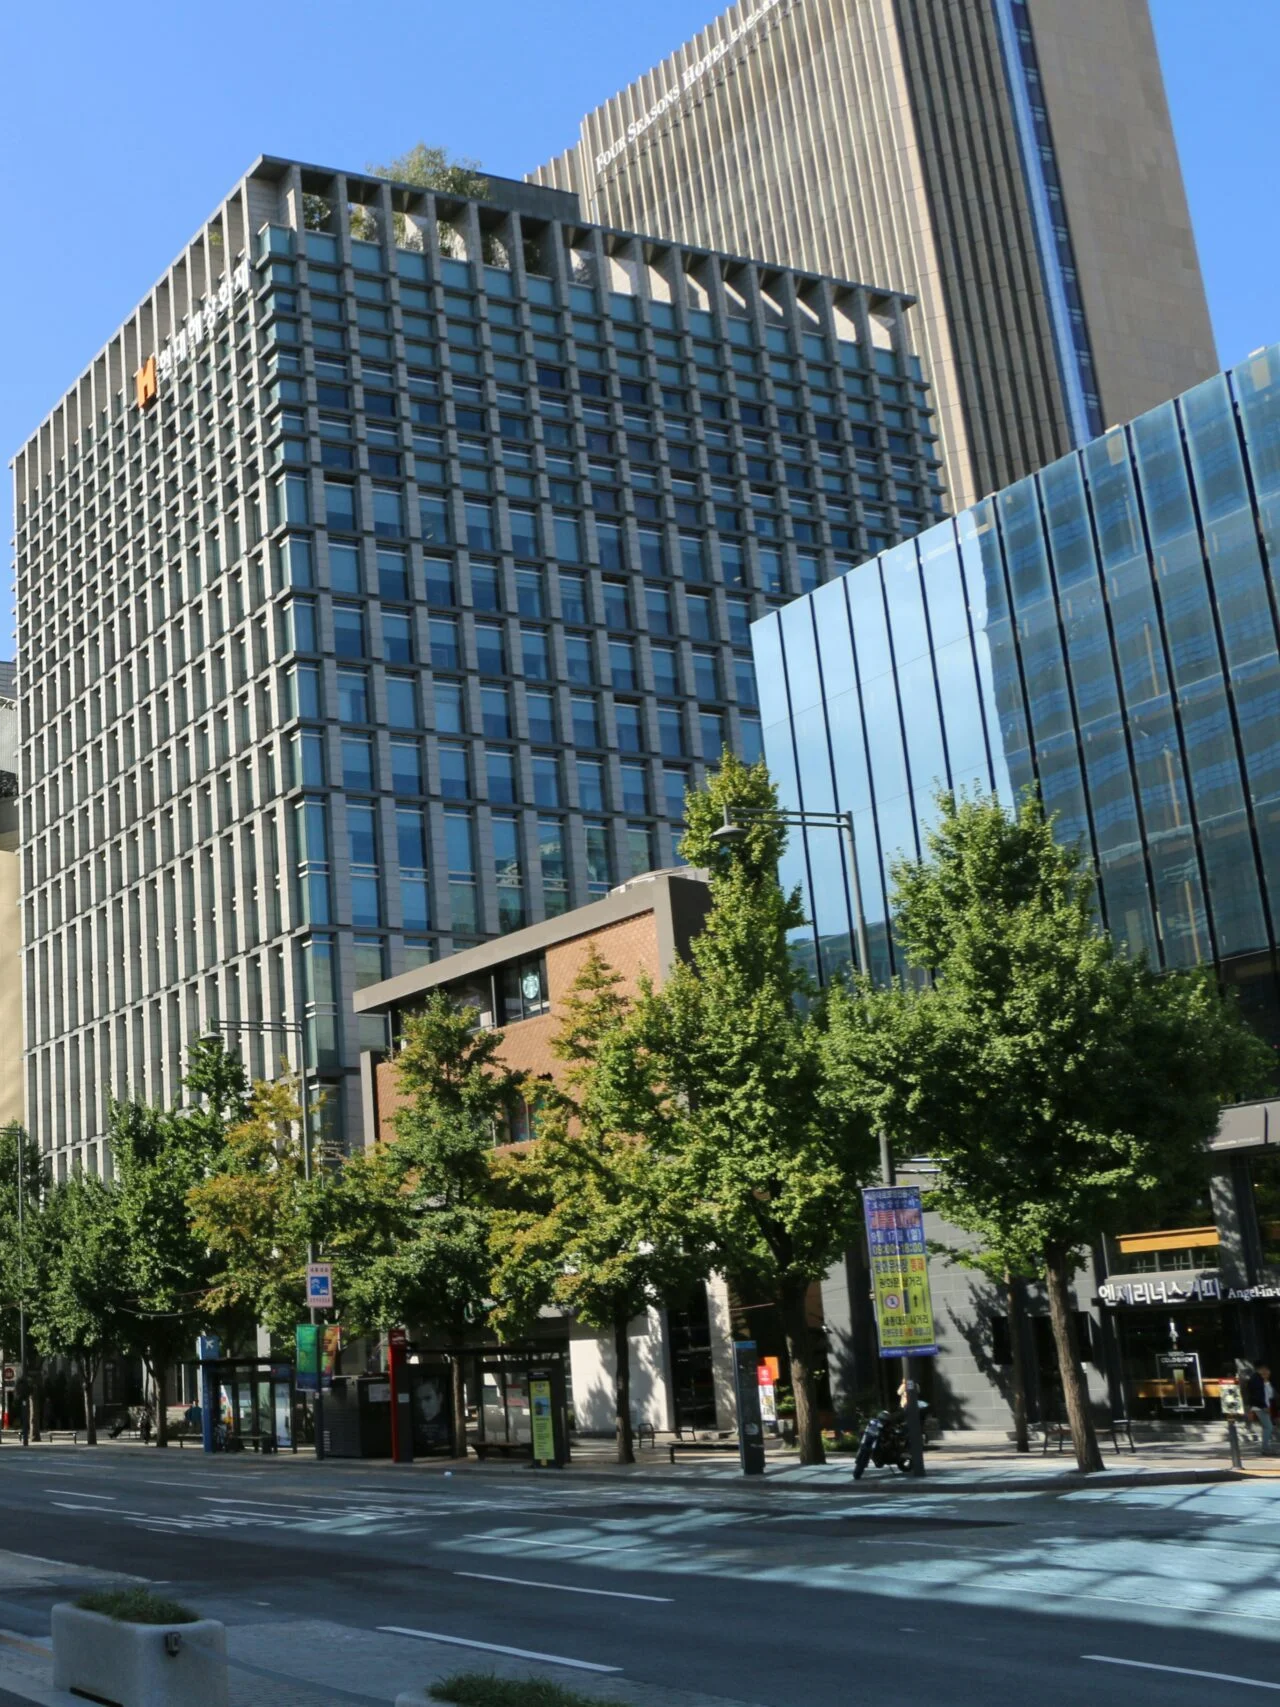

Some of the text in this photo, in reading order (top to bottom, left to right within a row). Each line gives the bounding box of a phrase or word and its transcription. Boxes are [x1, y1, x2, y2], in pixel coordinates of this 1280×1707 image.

[596, 40, 729, 174] FOUR SEASONS HOTEL
